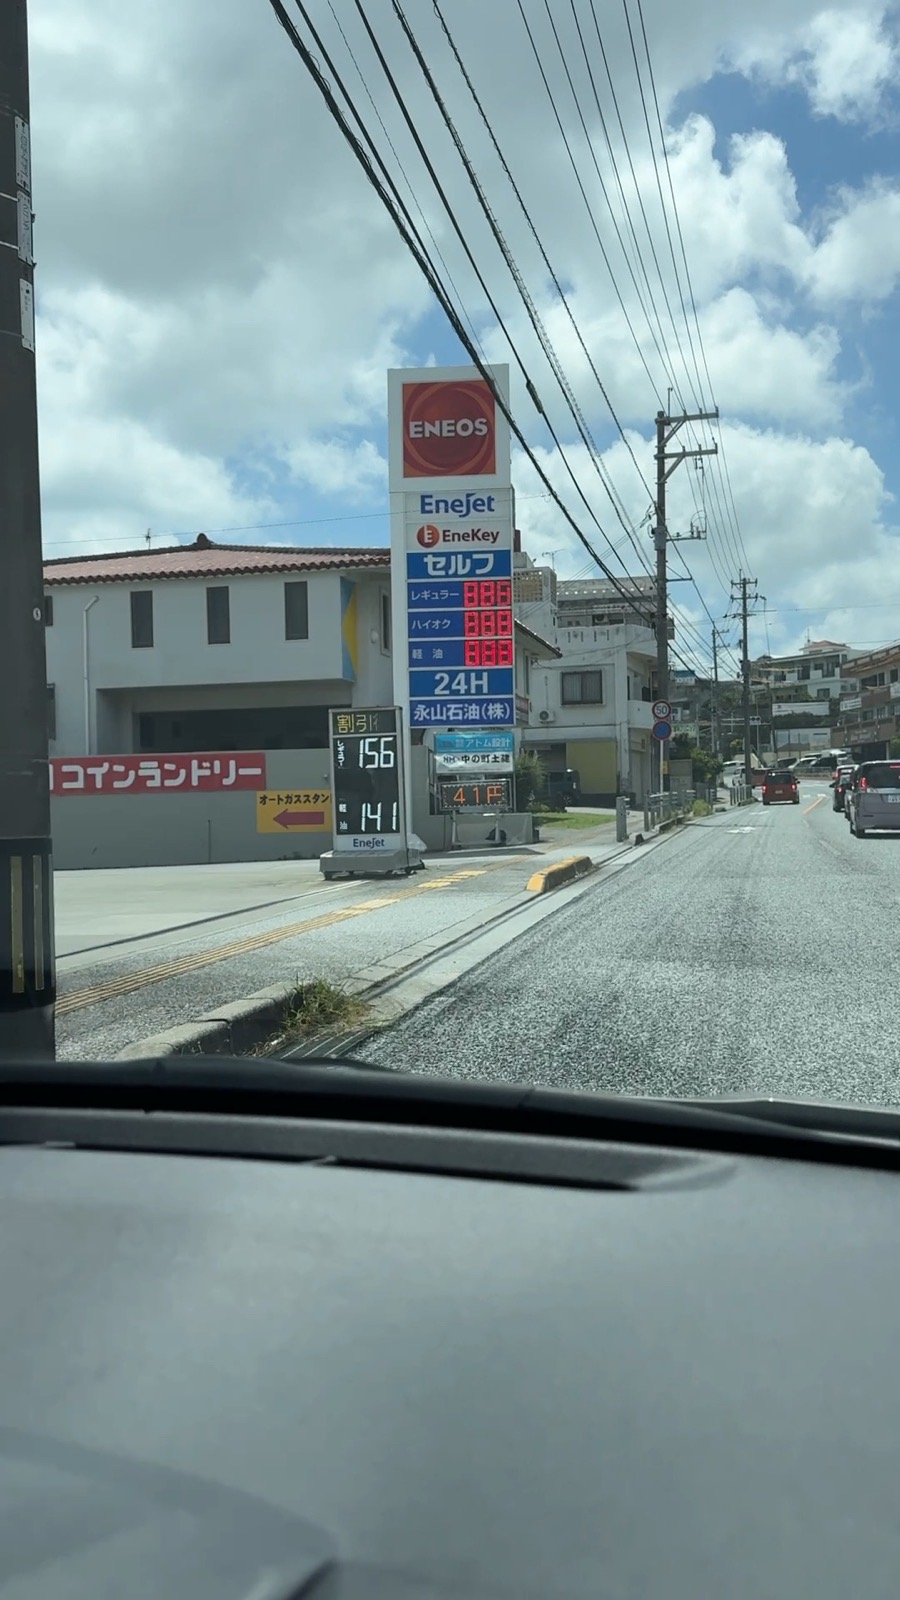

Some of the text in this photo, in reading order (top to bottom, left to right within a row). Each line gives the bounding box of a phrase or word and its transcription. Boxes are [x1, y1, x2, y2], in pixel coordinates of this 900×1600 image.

[409, 418, 488, 438] ENEOS
[442, 528, 500, 543] EneKey
[423, 553, 494, 576] セルフ
[411, 591, 460, 601] レギュラー
[411, 619, 452, 630] ハイオク
[434, 672, 489, 695] 24H
[414, 702, 510, 721] 永山石油(株)
[655, 705, 668, 715] 50
[358, 737, 394, 769] 156
[61, 759, 262, 789] コインランドリー
[259, 793, 332, 806] オートガススタン
[361, 801, 397, 832] 141
